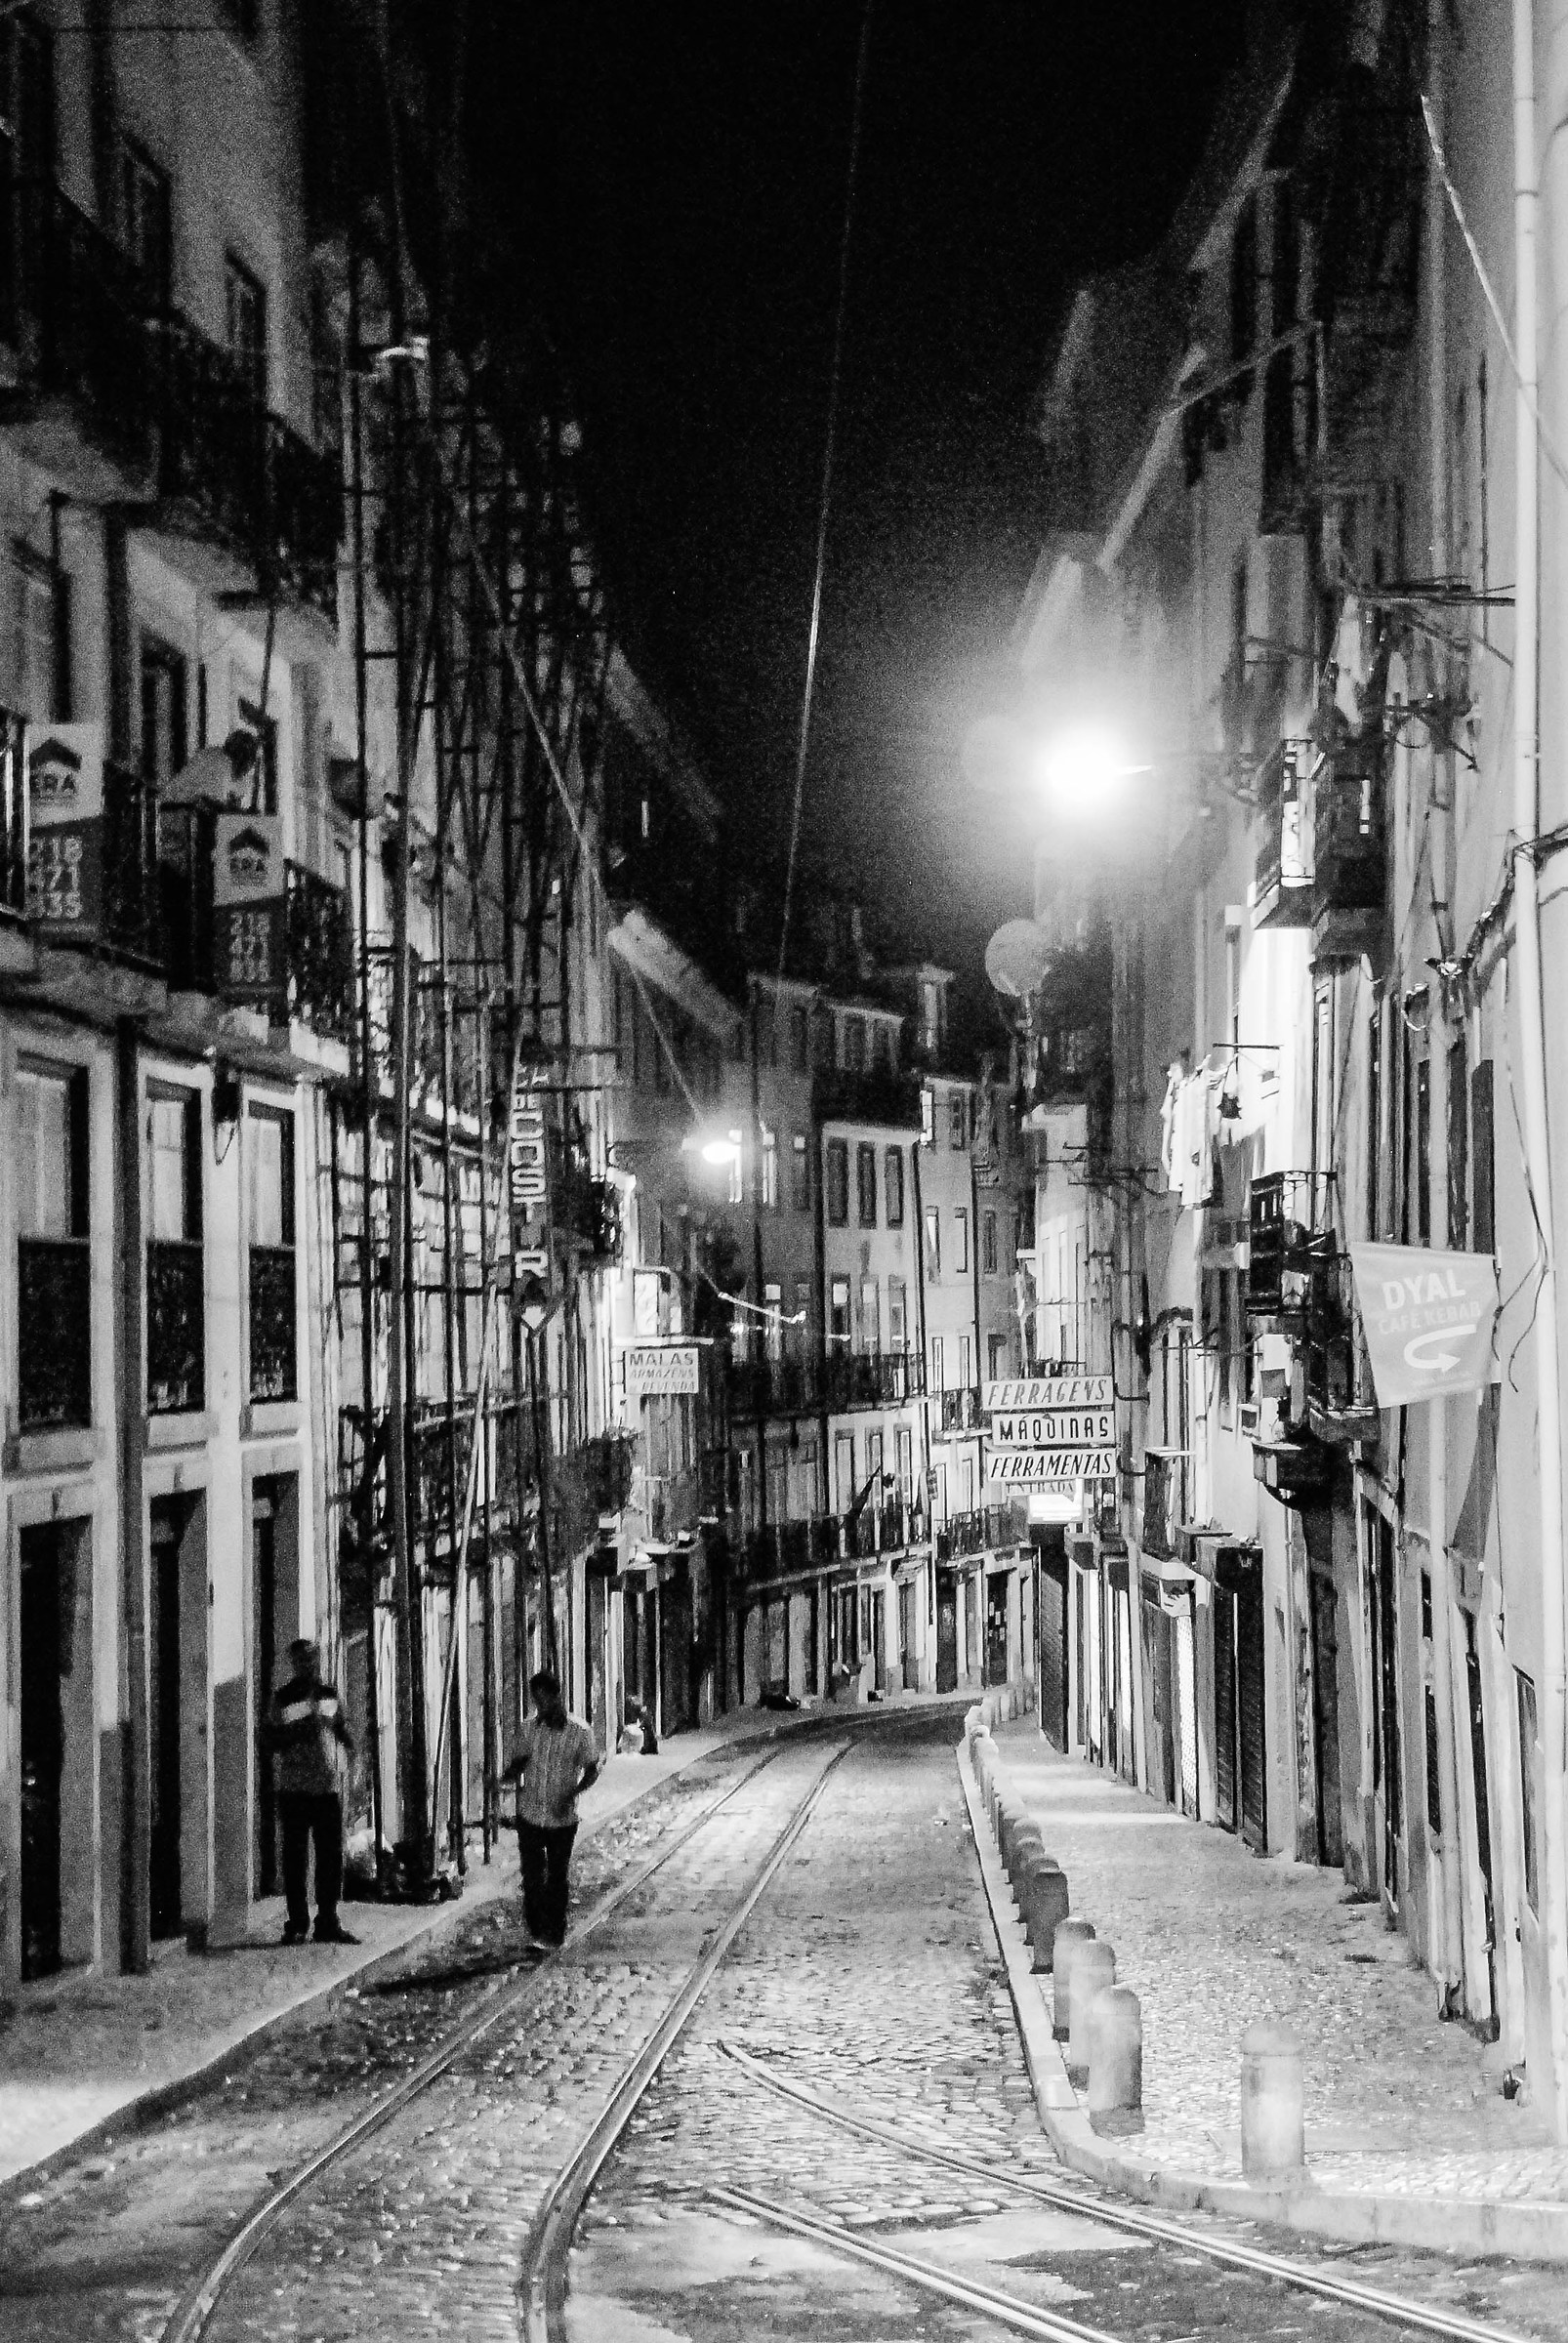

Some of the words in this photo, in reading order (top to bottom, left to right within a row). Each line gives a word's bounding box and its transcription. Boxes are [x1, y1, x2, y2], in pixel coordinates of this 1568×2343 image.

[30, 773, 77, 793] ERA
[1382, 1269, 1466, 1310] DYAL
[1424, 1300, 1482, 1326] KEBAB
[630, 1352, 693, 1366] MALAS
[987, 1378, 1107, 1406] FERRAGENS
[999, 1415, 1109, 1442] MÁQUINAS
[990, 1453, 1113, 1478] FERRAMENTAS
